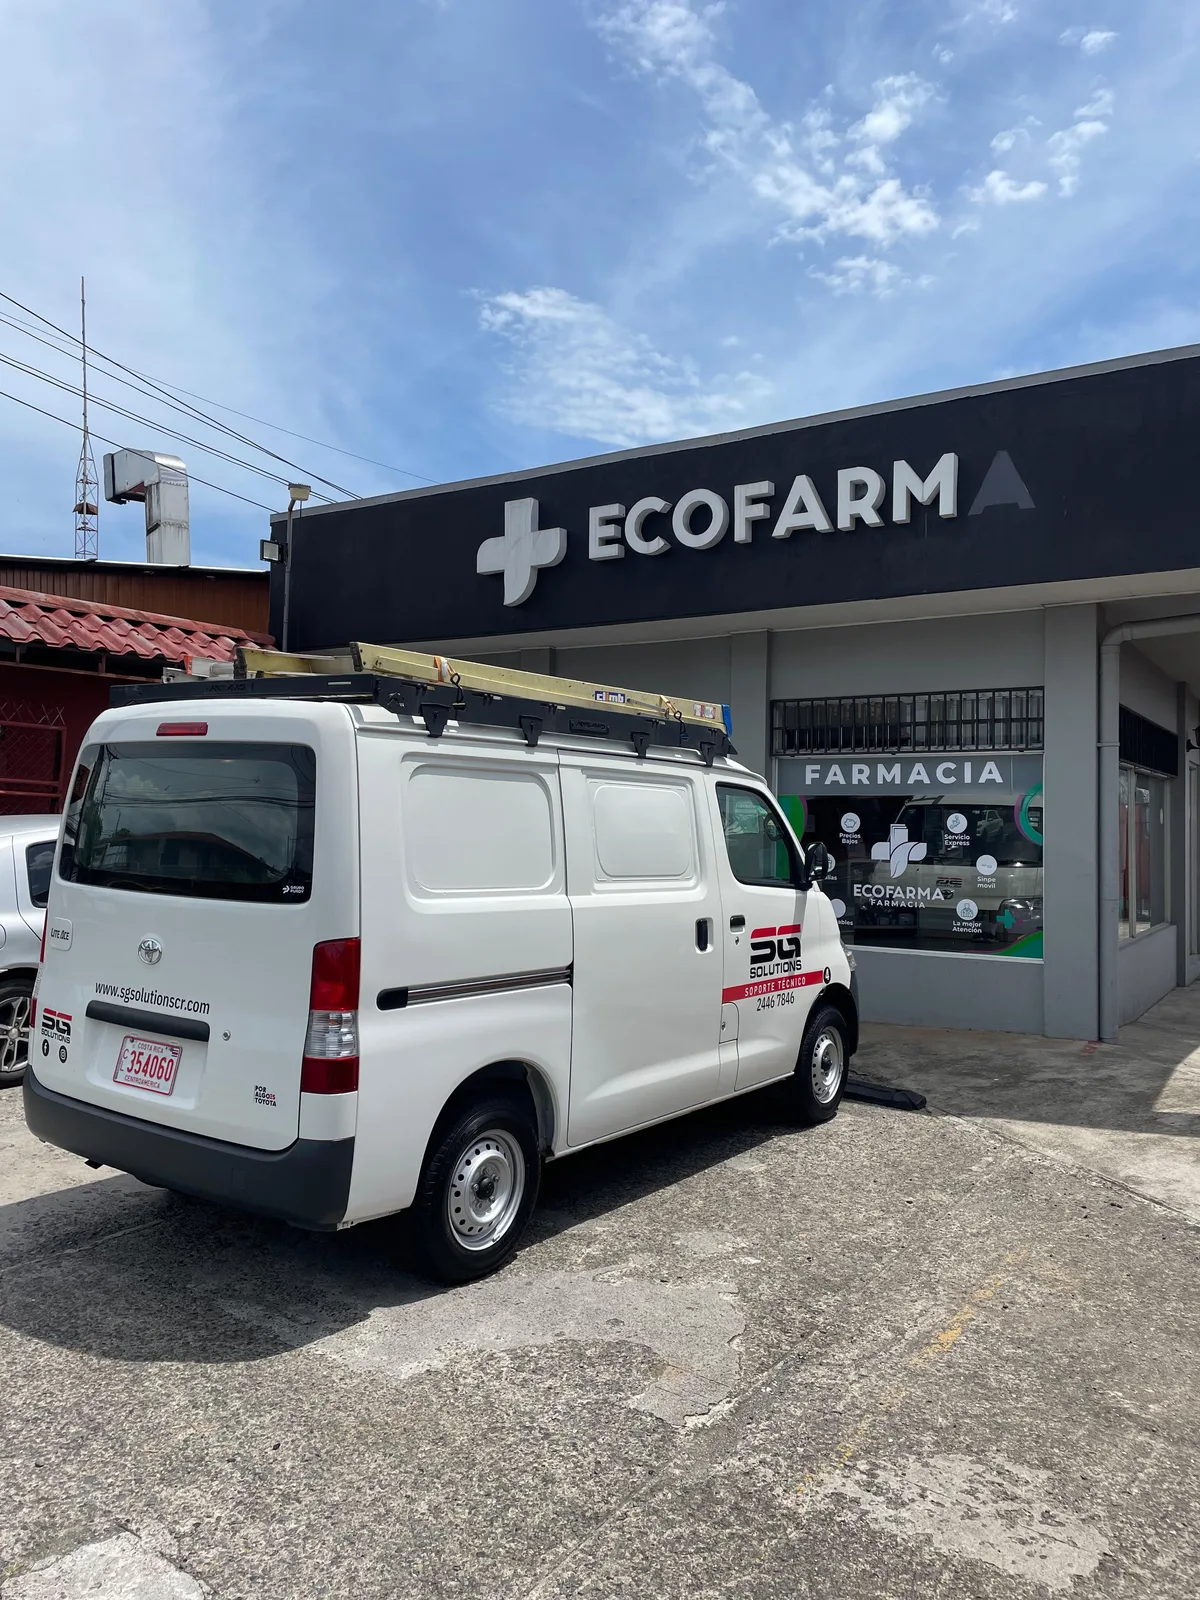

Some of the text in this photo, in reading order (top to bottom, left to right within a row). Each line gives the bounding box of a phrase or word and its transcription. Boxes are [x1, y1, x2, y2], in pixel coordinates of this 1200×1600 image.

[588, 449, 1035, 561] ECOFARMA
[596, 691, 624, 703] climb
[805, 761, 1004, 785] FARMACIA
[854, 884, 945, 901] ECOFARMA
[870, 899, 926, 908] FARMACIA
[952, 926, 982, 934] Atención
[962, 921, 982, 929] mejor
[750, 924, 801, 965] SG
[750, 960, 802, 979] SOLUTIONS
[744, 977, 806, 997] SOPORTE TÉCNICO
[95, 982, 210, 1014] www.sgsolutionscr.com
[757, 991, 795, 1011] 2446 7846
[41, 1028, 71, 1044] SOLUTIONS
[137, 1043, 152, 1051] COSTA
[127, 1050, 174, 1082] 354060
[124, 1075, 160, 1088] CENTROAMERICA
[255, 1085, 266, 1093] POR
[255, 1098, 276, 1107] TOYOTA
